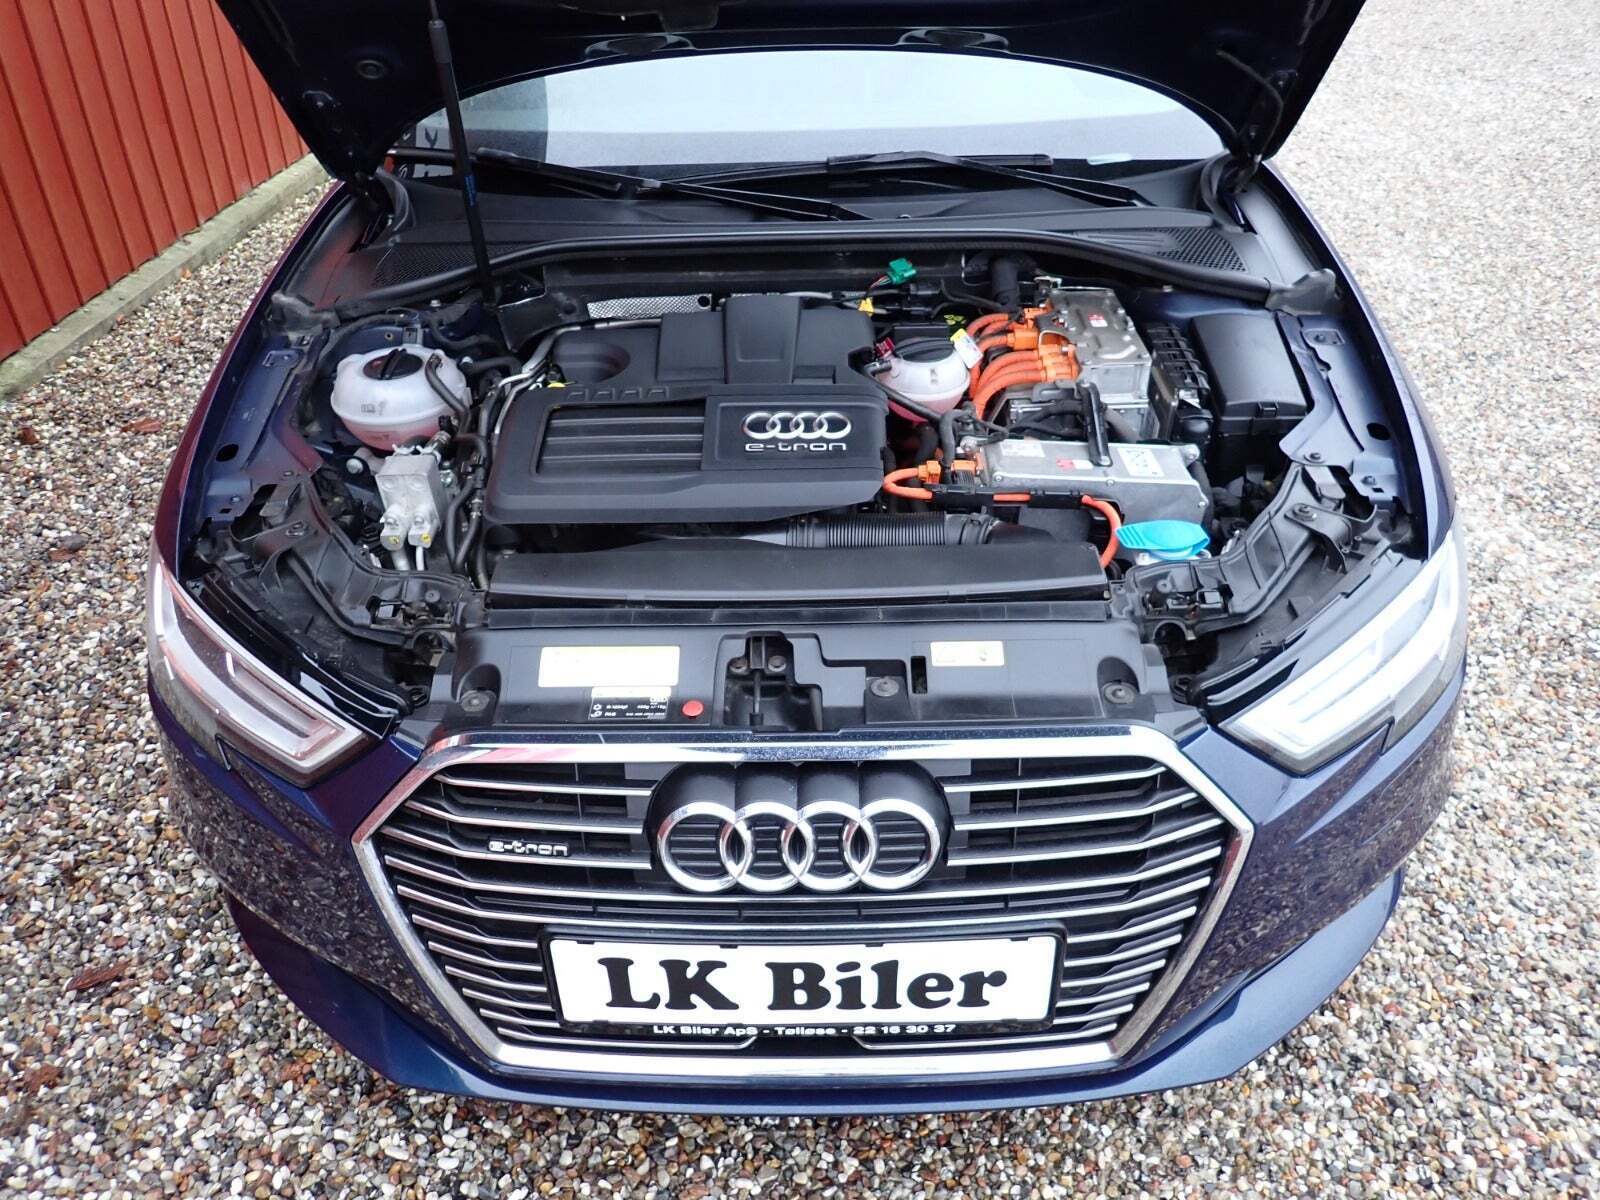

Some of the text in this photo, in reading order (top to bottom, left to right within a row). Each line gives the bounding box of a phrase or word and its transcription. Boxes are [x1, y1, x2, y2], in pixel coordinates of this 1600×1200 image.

[745, 442, 847, 452] e-tron
[488, 840, 568, 857] e-tron
[597, 957, 1008, 1010] LK Biler
[653, 1025, 676, 1034] LK
[680, 1025, 719, 1035] Biler
[724, 1026, 758, 1037] ApS
[853, 1026, 876, 1034] 22
[881, 1025, 900, 1034] 16
[906, 1025, 929, 1033] 30
[933, 1024, 956, 1033] 37
